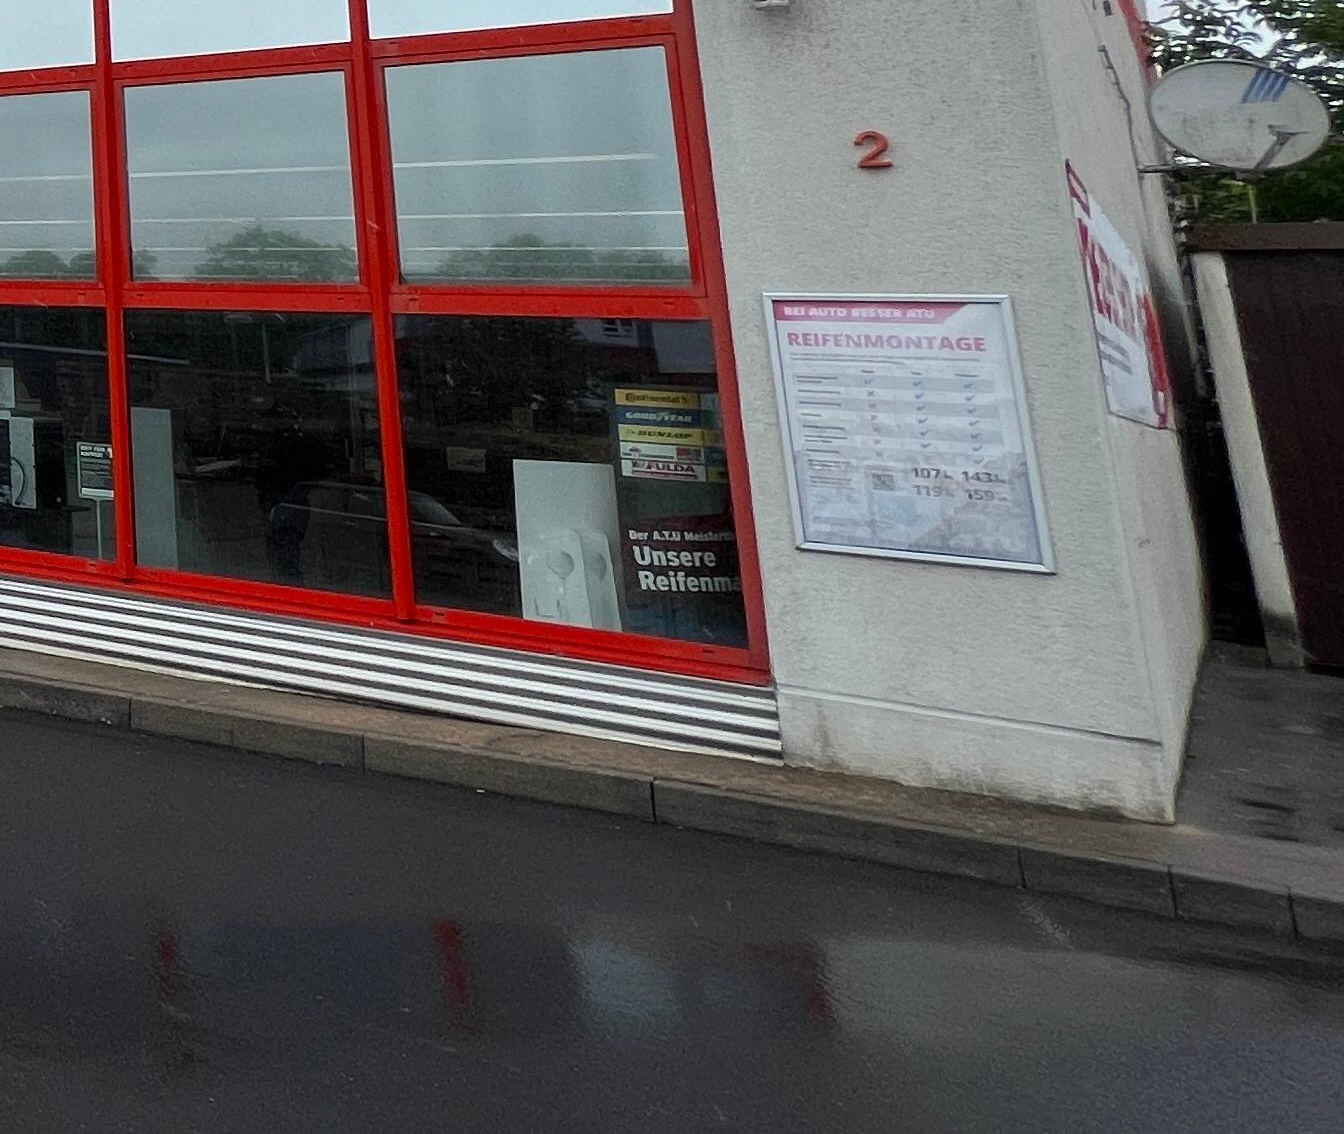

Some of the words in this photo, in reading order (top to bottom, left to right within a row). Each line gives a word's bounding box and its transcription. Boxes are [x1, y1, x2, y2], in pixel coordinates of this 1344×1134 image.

[853, 130, 894, 169] 2
[784, 306, 805, 316] BEI
[809, 307, 847, 317] AUTO
[786, 332, 986, 352] REIFENMONTAGE
[638, 429, 693, 440] DUNLOP
[628, 529, 649, 541] Der
[632, 545, 717, 567] Unsere
